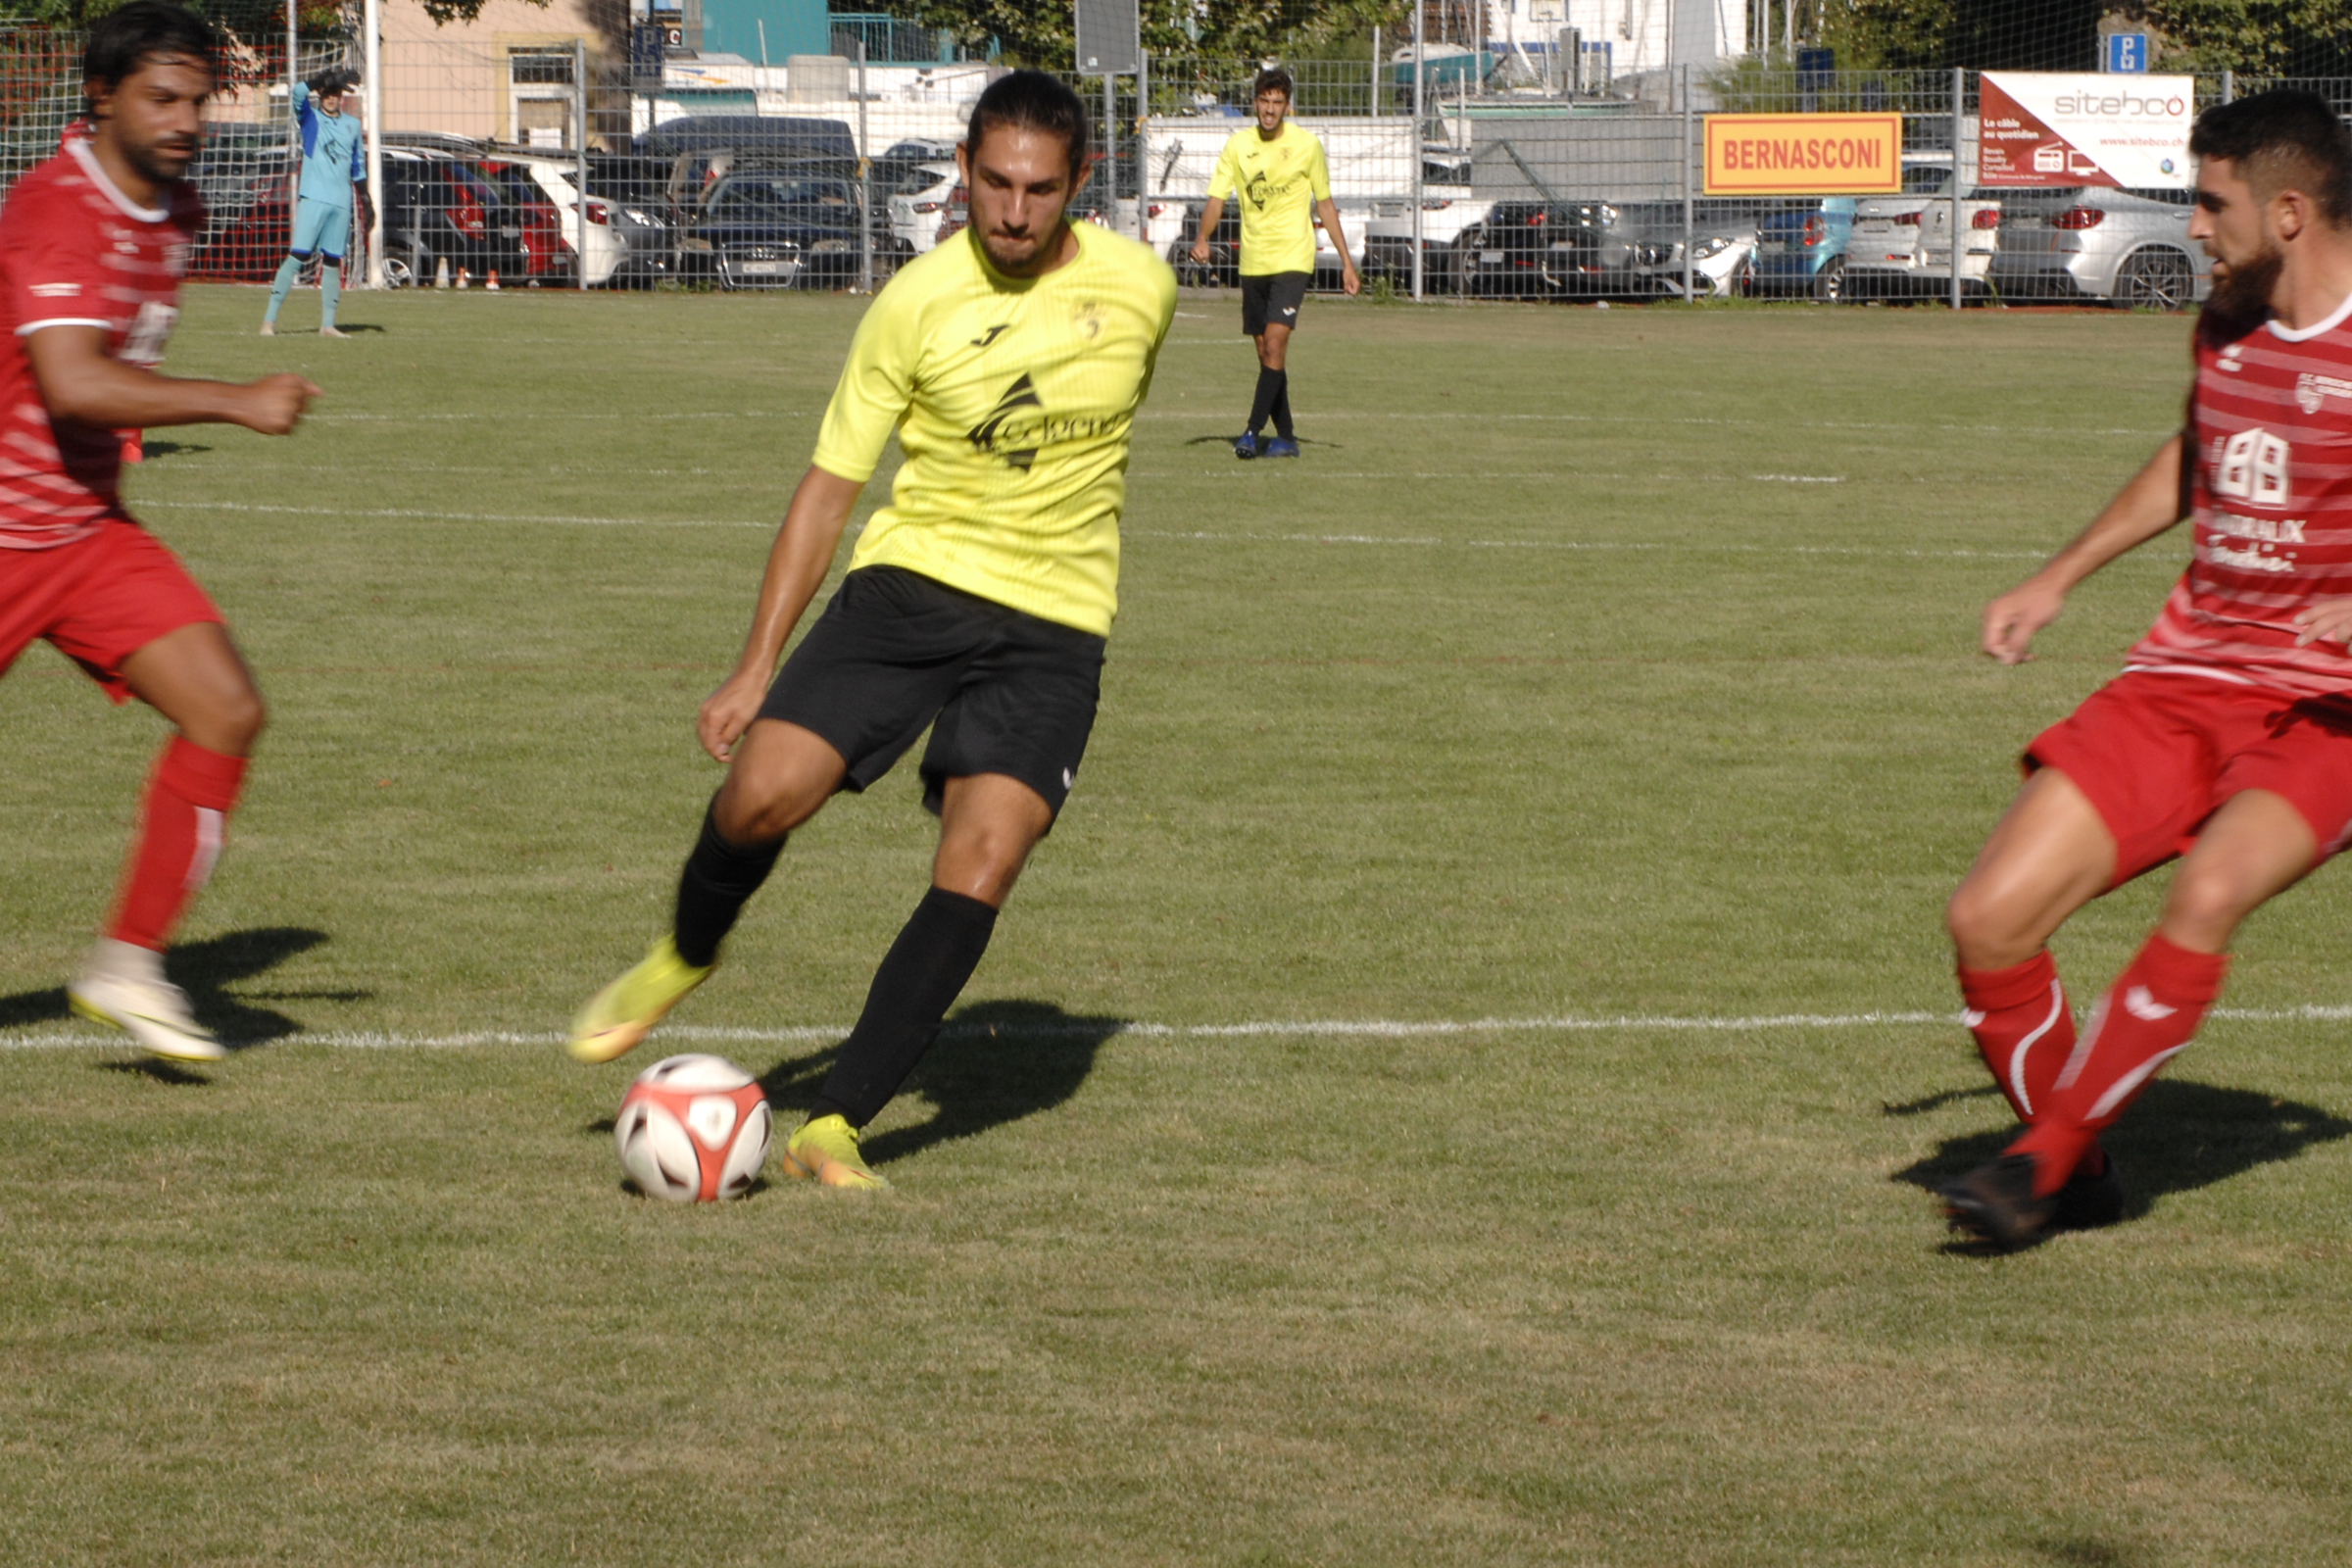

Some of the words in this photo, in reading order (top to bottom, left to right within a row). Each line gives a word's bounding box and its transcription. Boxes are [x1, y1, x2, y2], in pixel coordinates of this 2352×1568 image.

[2122, 37, 2134, 55] P
[1984, 119, 1995, 127] Le
[1996, 118, 2021, 127] câble
[1996, 129, 2039, 140] quotidien
[2100, 136, 2184, 147] www.sitebco.ch
[1724, 138, 1881, 170] BERNASCONI
